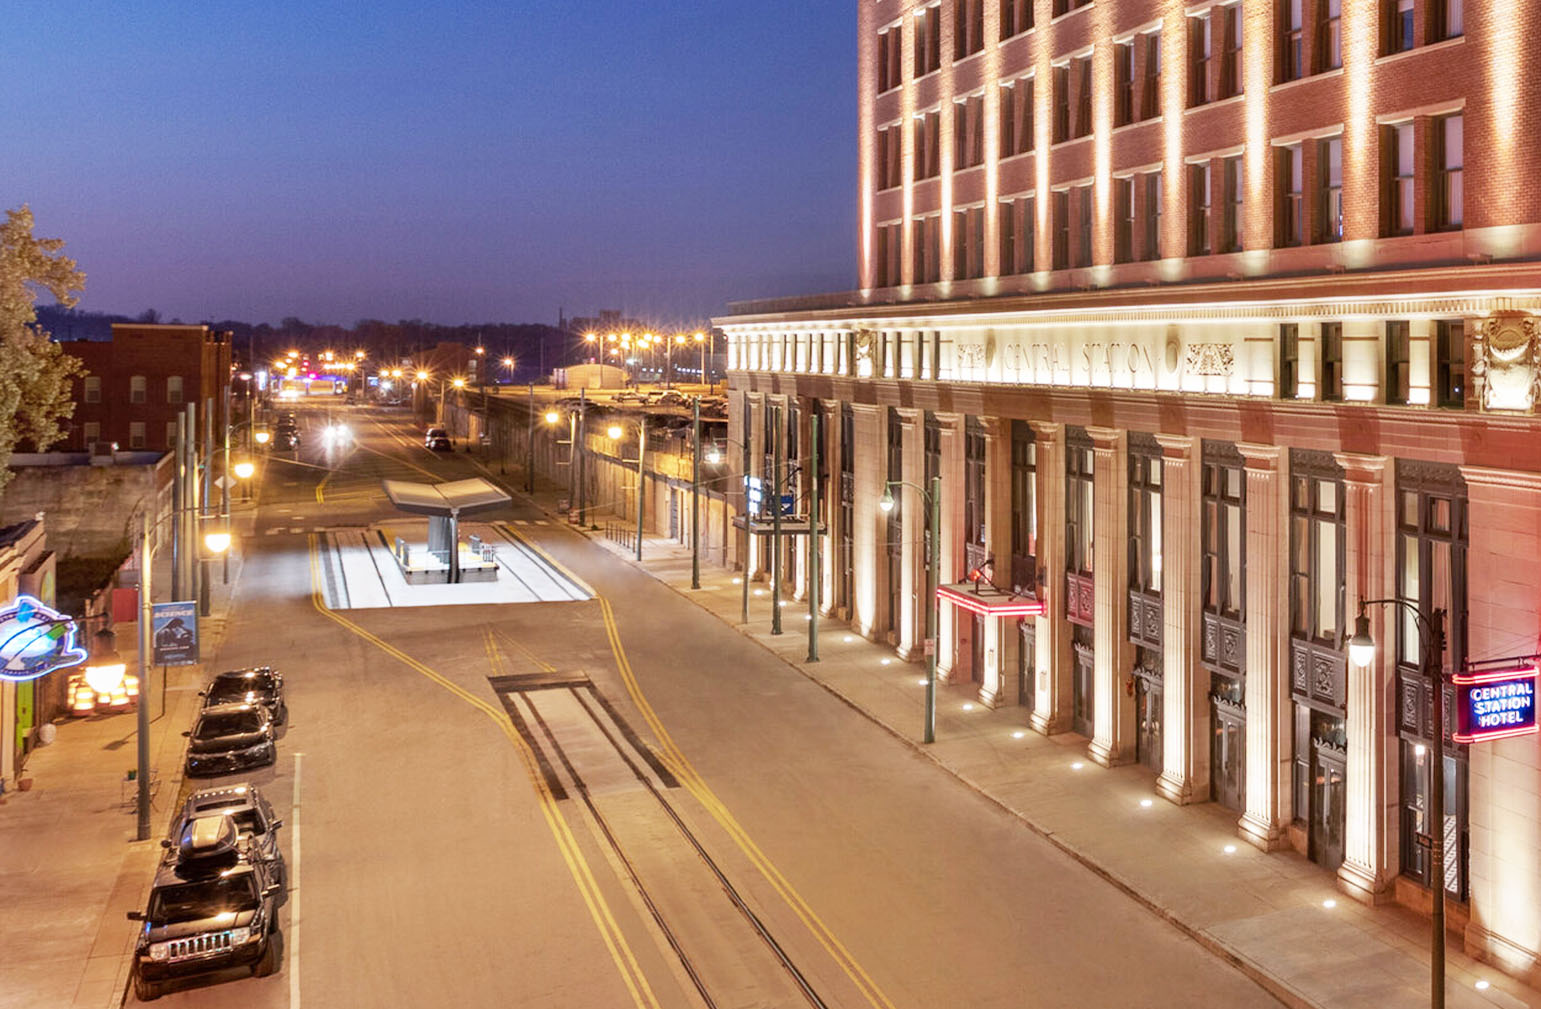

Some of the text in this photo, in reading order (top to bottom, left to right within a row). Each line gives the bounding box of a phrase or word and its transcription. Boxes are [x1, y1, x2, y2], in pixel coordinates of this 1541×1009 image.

[1004, 343, 1155, 373] CENTRAL STATION
[1471, 682, 1533, 702] CENTRAL
[1474, 696, 1531, 715] STATION
[1480, 710, 1524, 728] HOTEL
